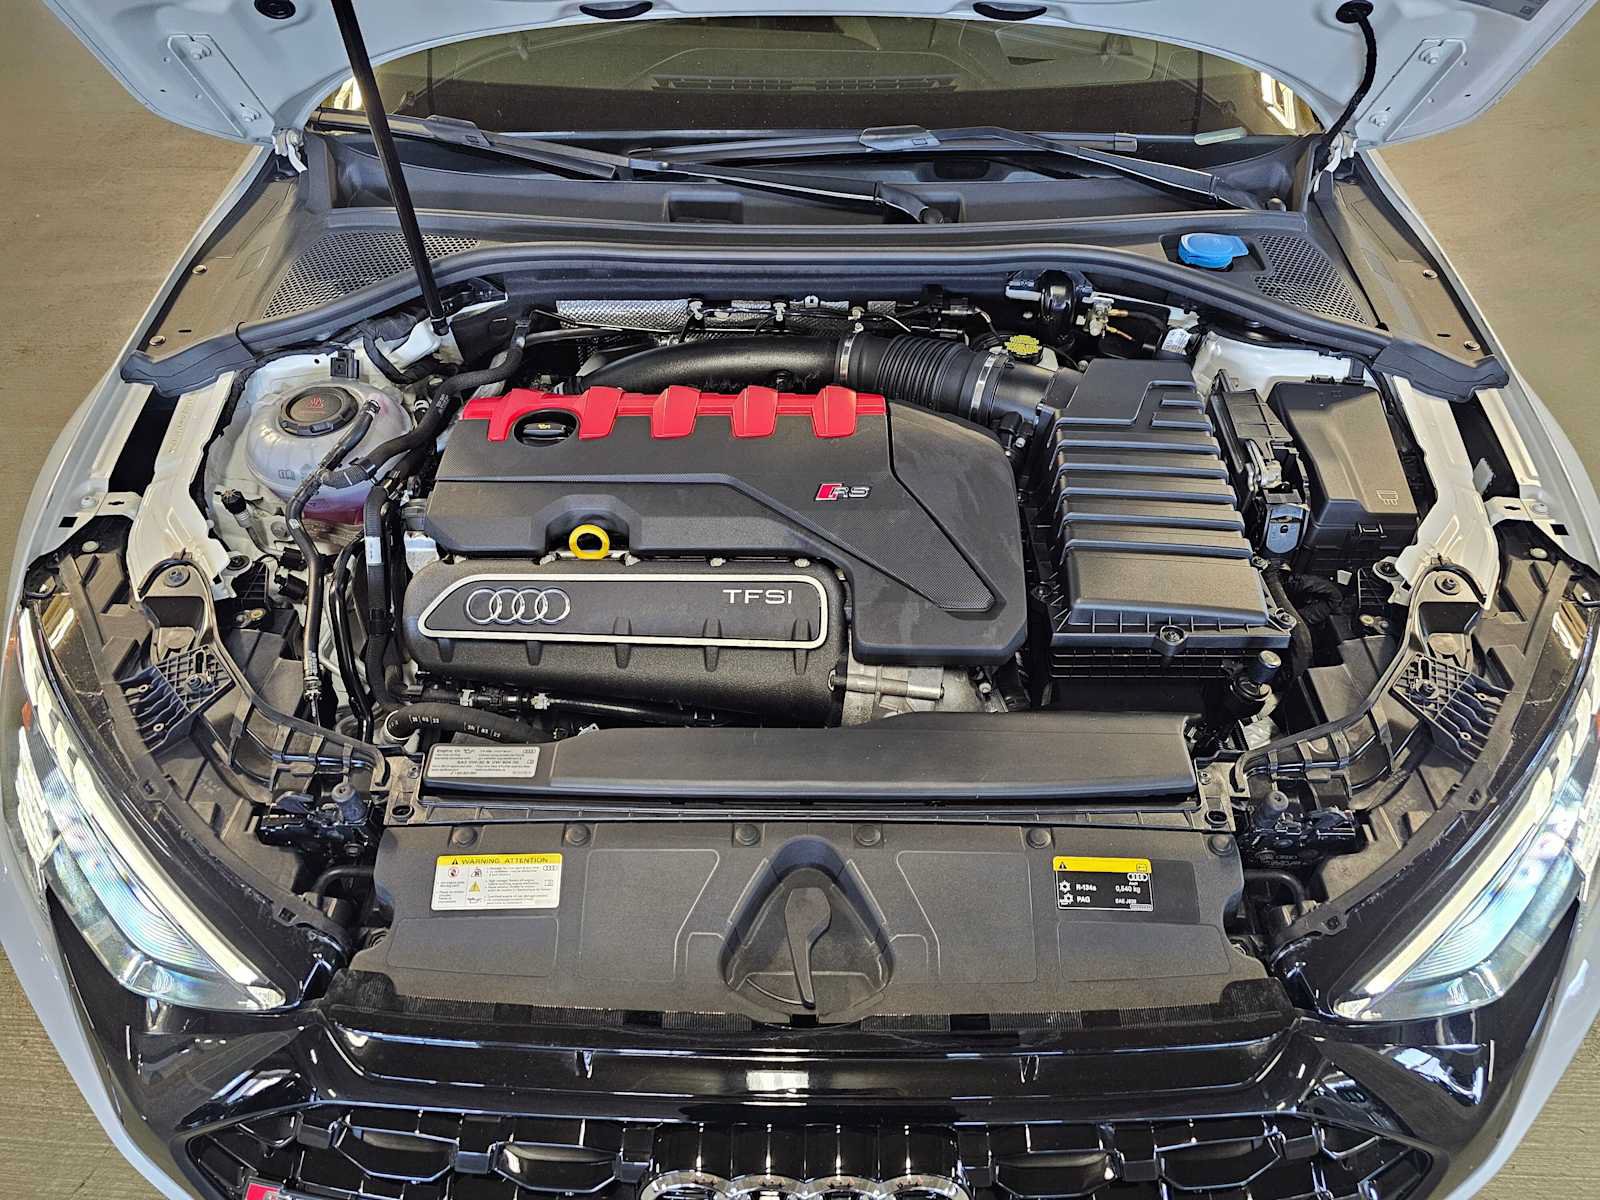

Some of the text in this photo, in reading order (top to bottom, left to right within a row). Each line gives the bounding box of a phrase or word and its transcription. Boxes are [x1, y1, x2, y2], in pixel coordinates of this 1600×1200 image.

[817, 484, 870, 500] RS
[722, 588, 793, 604] TFSI
[461, 856, 549, 865] WARNING ATTENTION
[1075, 883, 1097, 892] R-134a
[1133, 885, 1141, 894] kg
[1076, 895, 1091, 904] PAG
